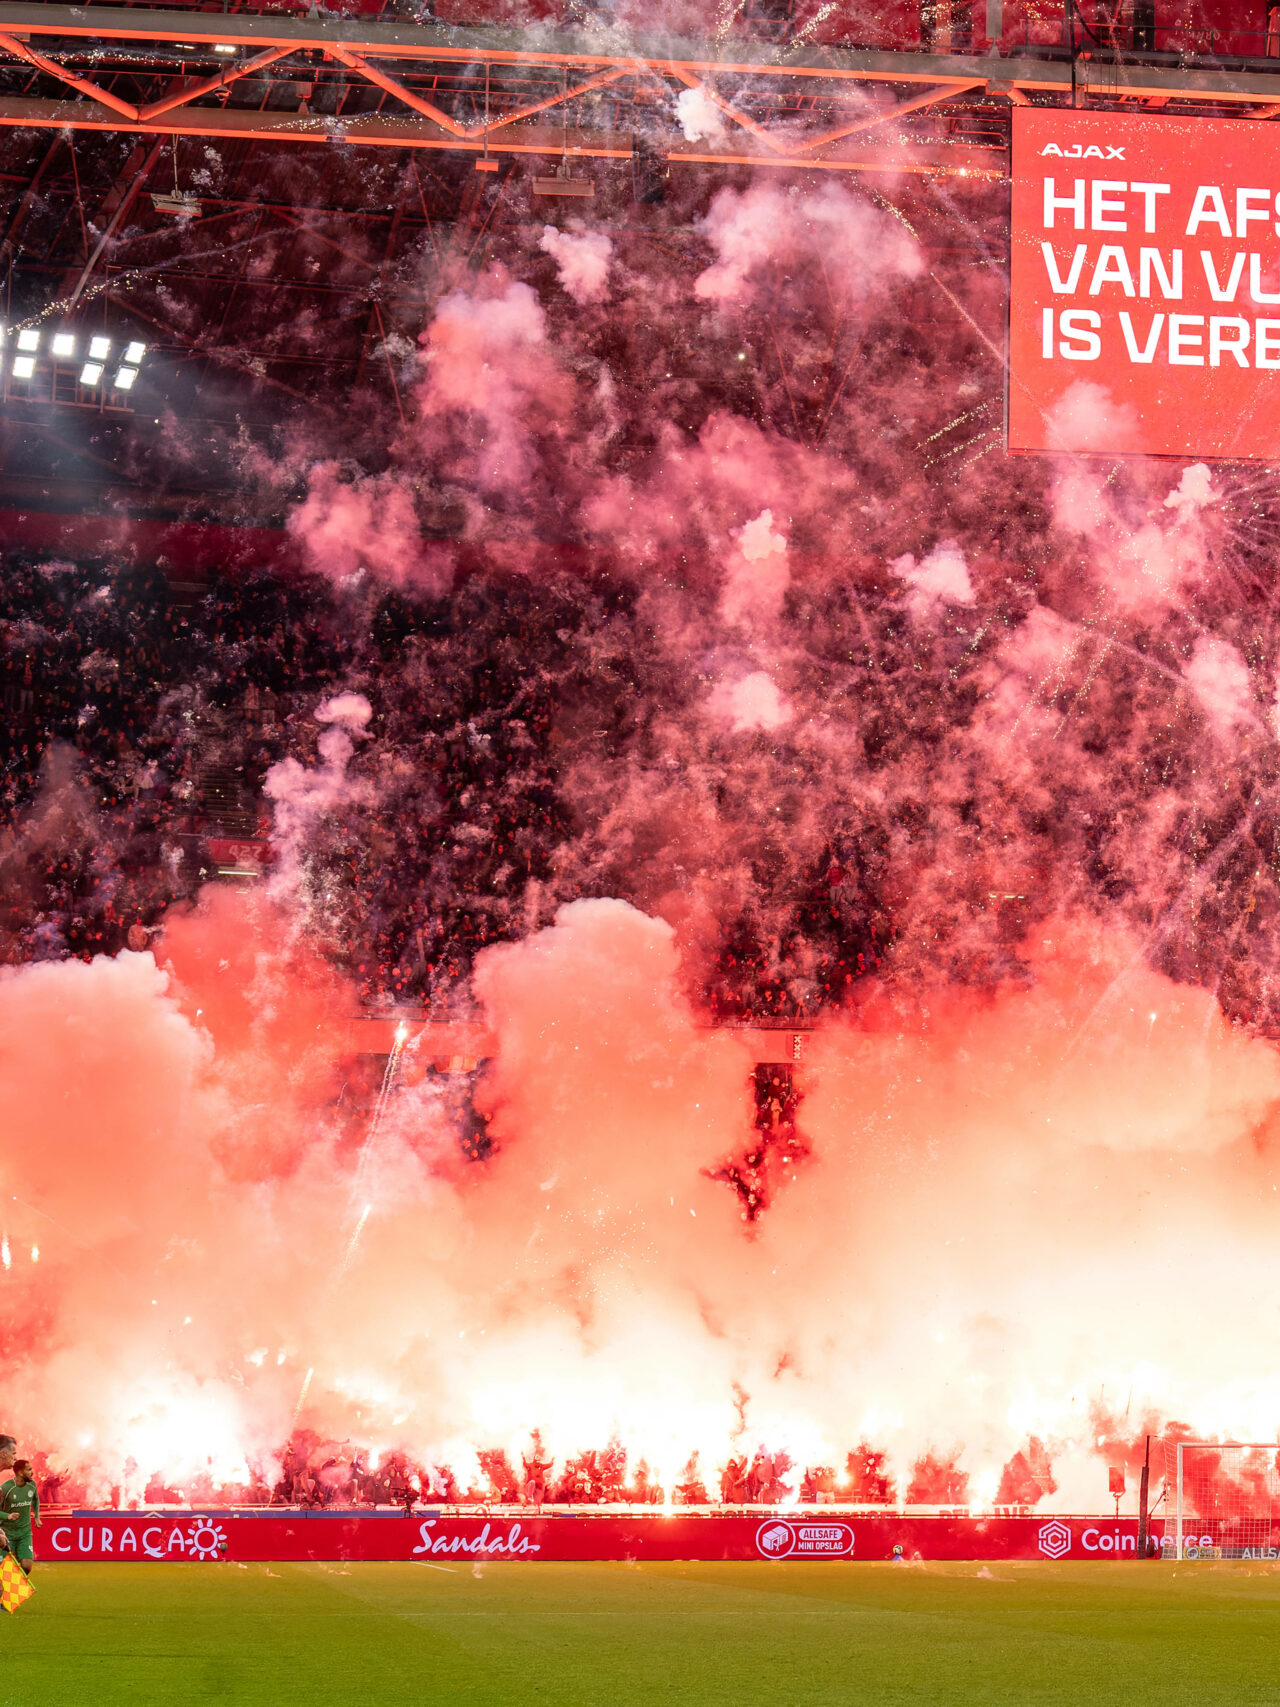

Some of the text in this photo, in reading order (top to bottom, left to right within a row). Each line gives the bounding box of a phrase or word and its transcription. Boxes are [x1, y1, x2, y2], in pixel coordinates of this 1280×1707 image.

[1040, 142, 1126, 160] AJAX
[1042, 177, 1171, 234] HET
[1041, 242, 1183, 299] VAN
[1041, 307, 1101, 361] IS
[412, 1519, 541, 1555] Sandals
[797, 1541, 844, 1550] MINI OPSLAG
[802, 1528, 839, 1539] ALLSAFE
